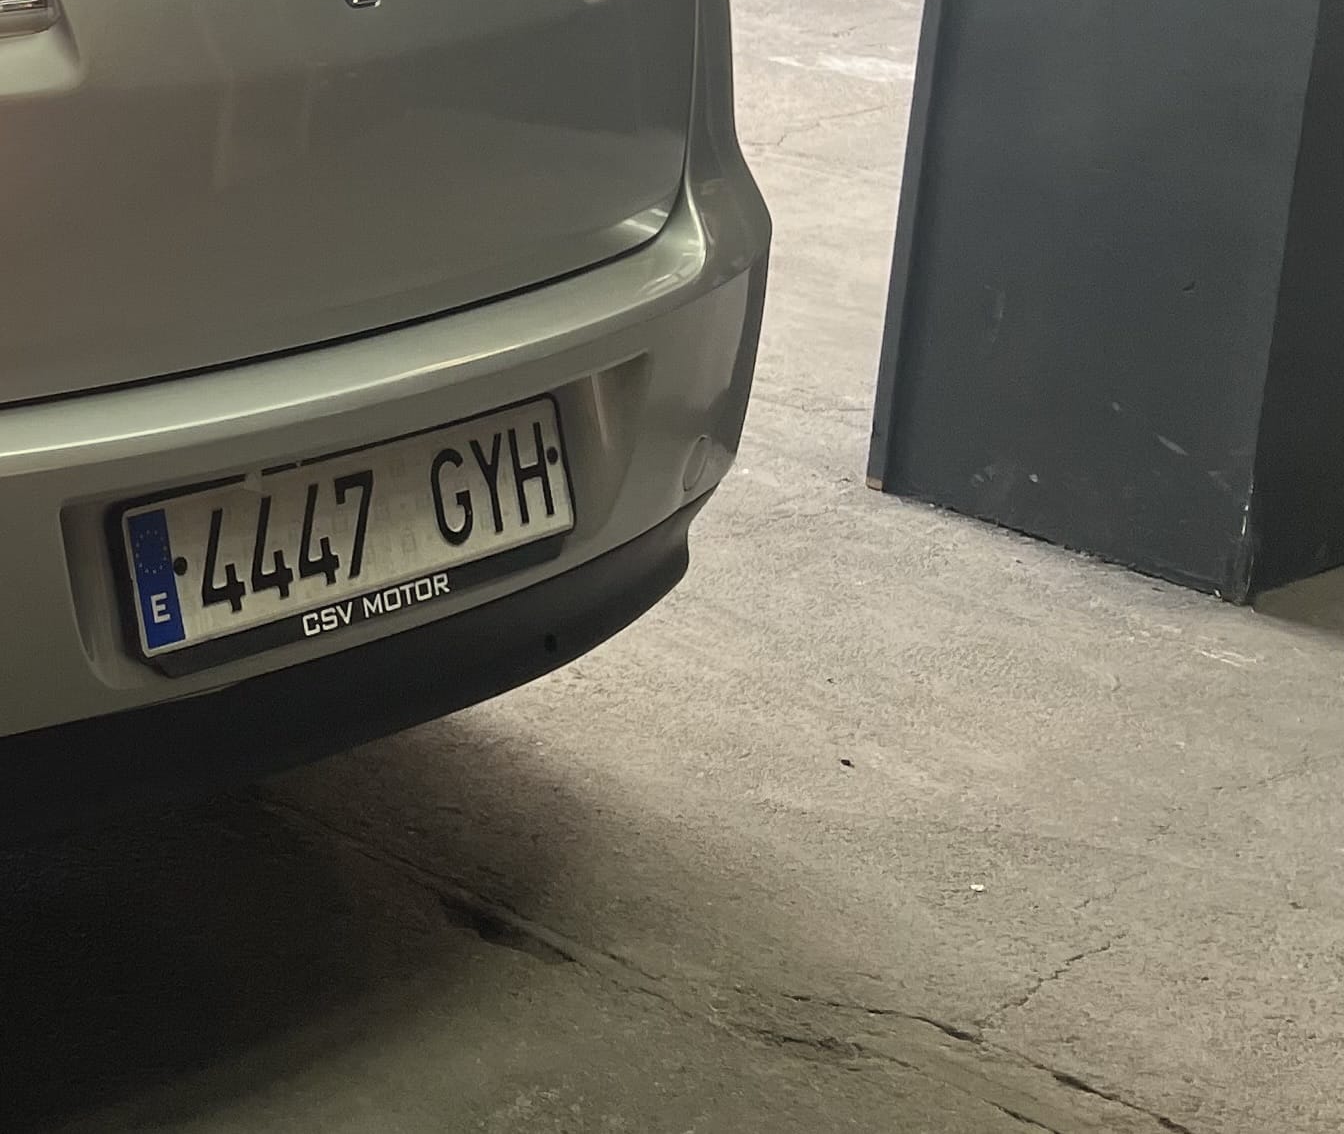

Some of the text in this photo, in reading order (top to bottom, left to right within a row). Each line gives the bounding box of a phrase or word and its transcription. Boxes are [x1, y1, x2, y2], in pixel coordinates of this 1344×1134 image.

[201, 421, 556, 614] 4447 GYH
[150, 592, 172, 624] E
[302, 572, 451, 637] CSV MOTOR
